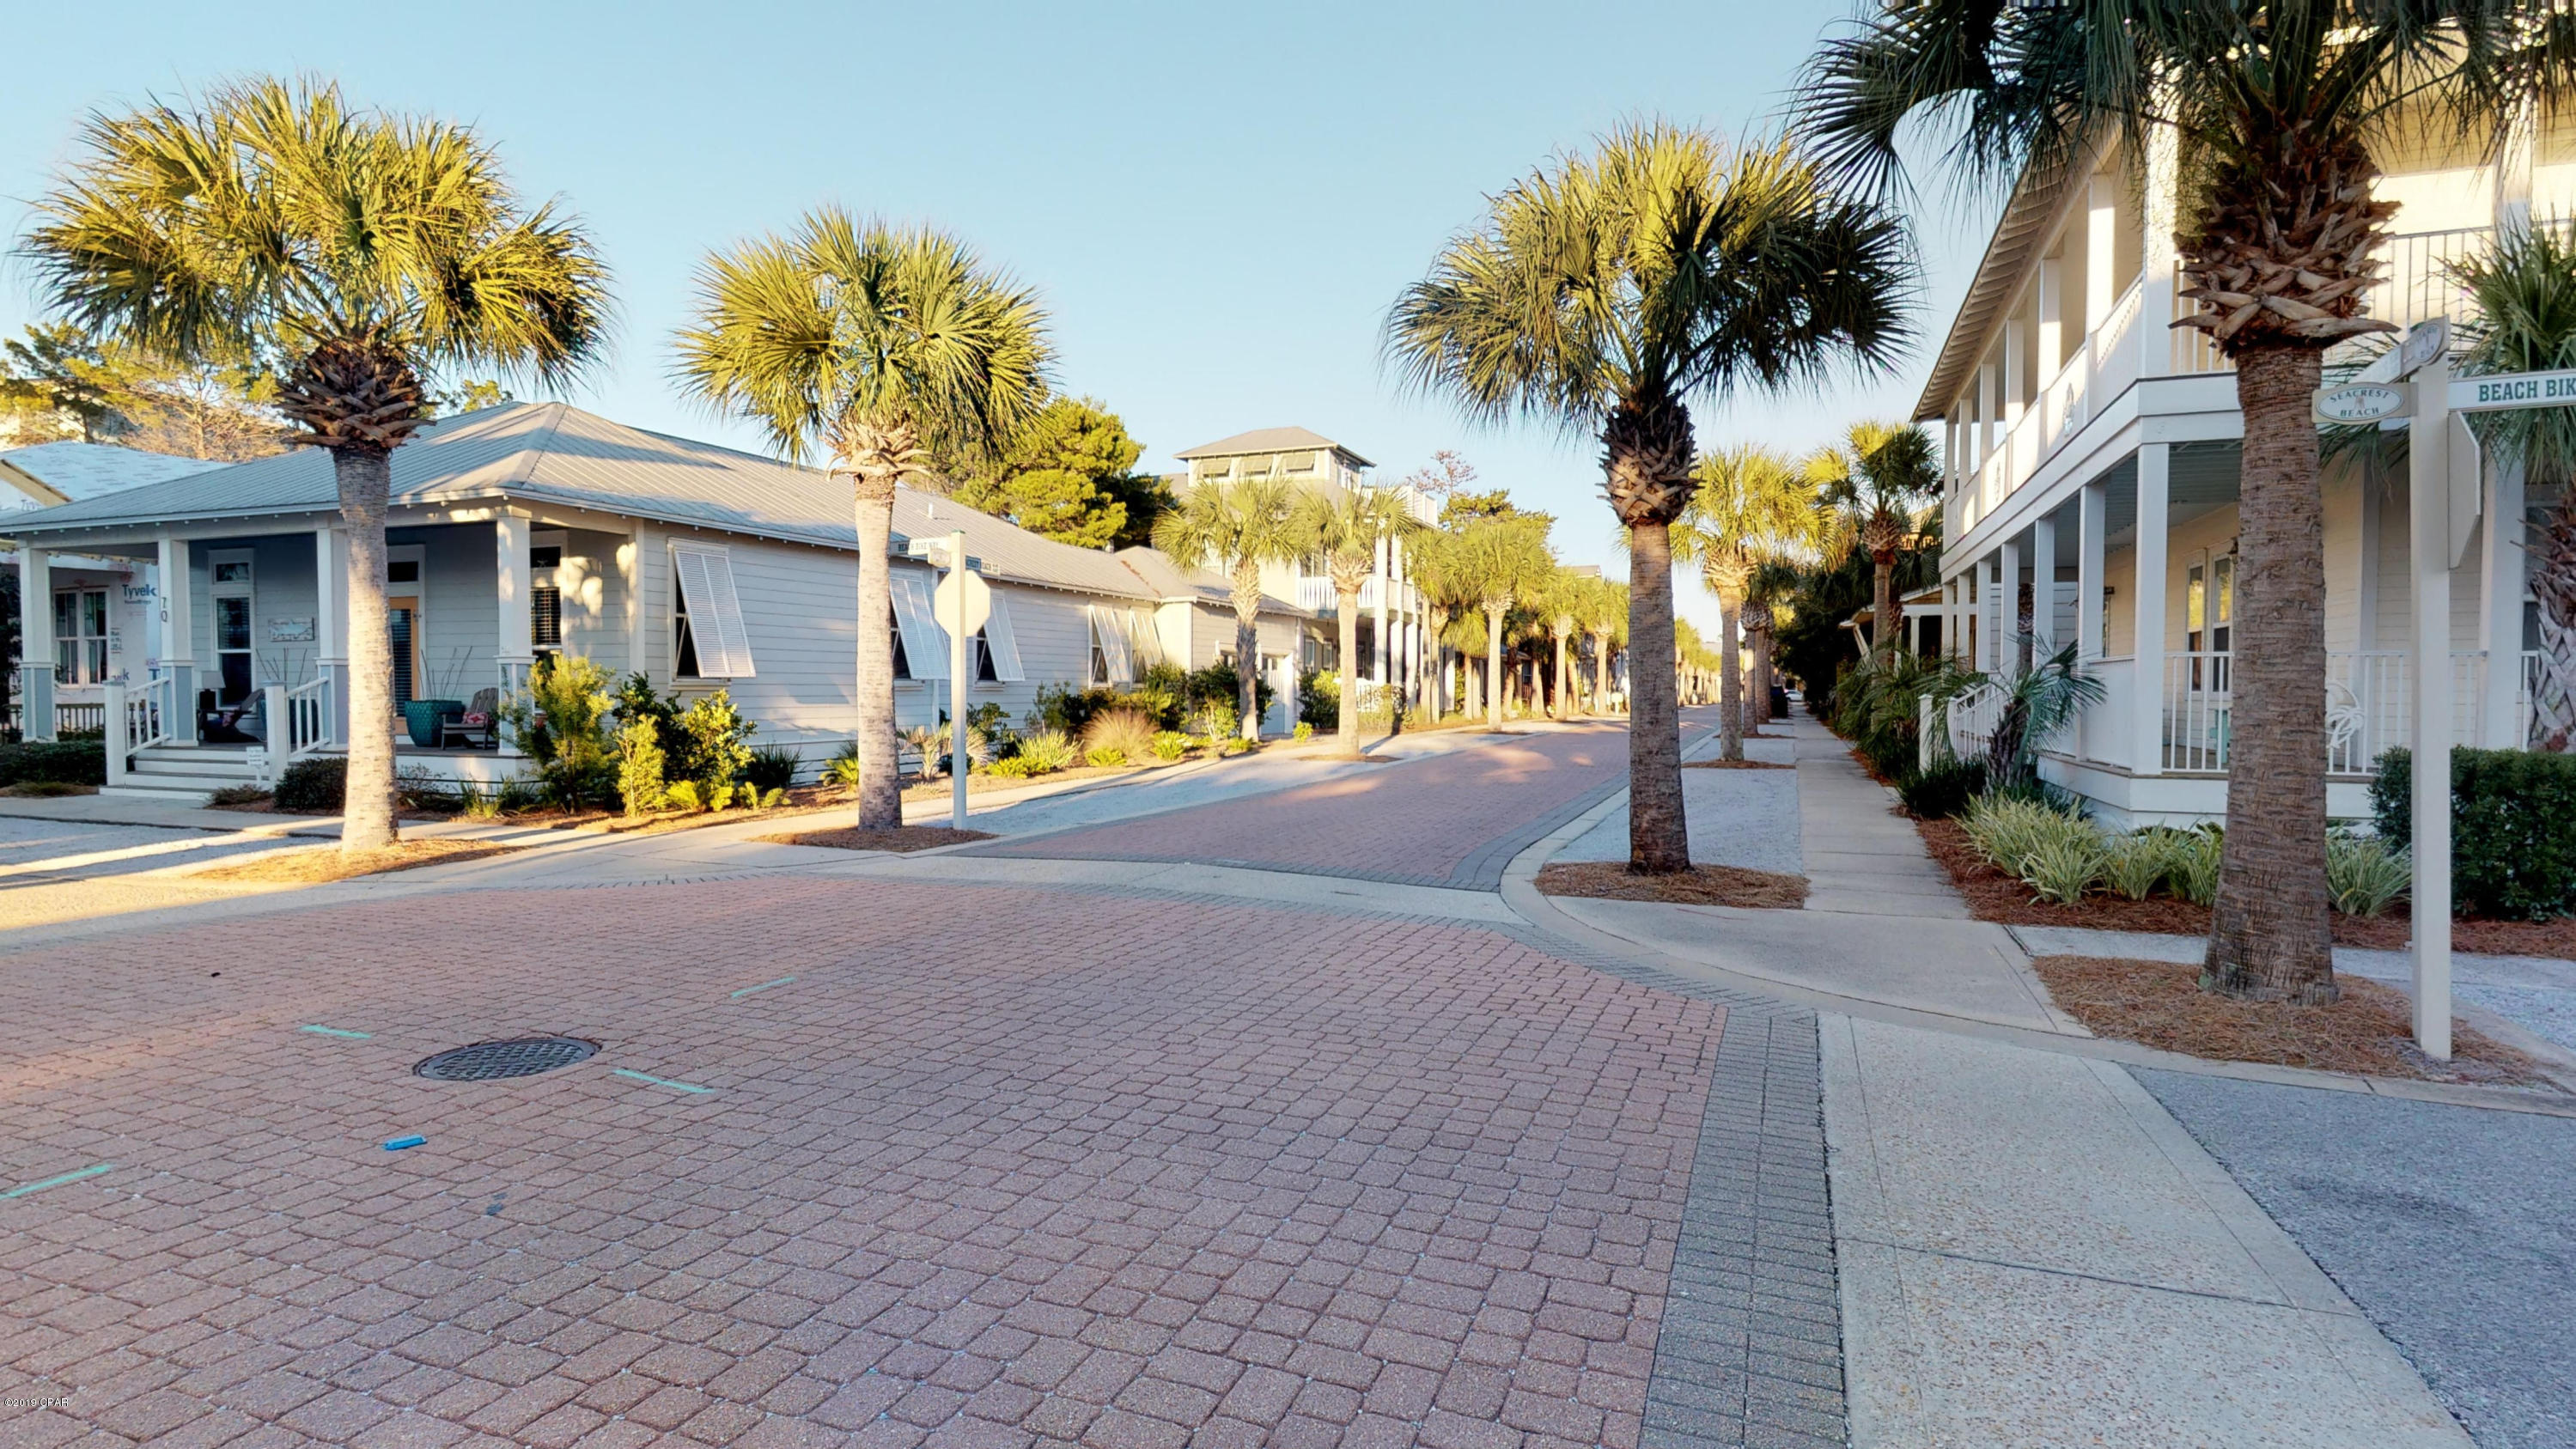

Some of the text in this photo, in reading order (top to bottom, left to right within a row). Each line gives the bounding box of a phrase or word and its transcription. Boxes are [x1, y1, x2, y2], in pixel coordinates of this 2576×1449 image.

[2329, 388, 2390, 404] SEACREST
[2478, 377, 2576, 402] BEACH BIK
[2340, 407, 2379, 417] BEACH
[122, 584, 158, 600] Tyvek
